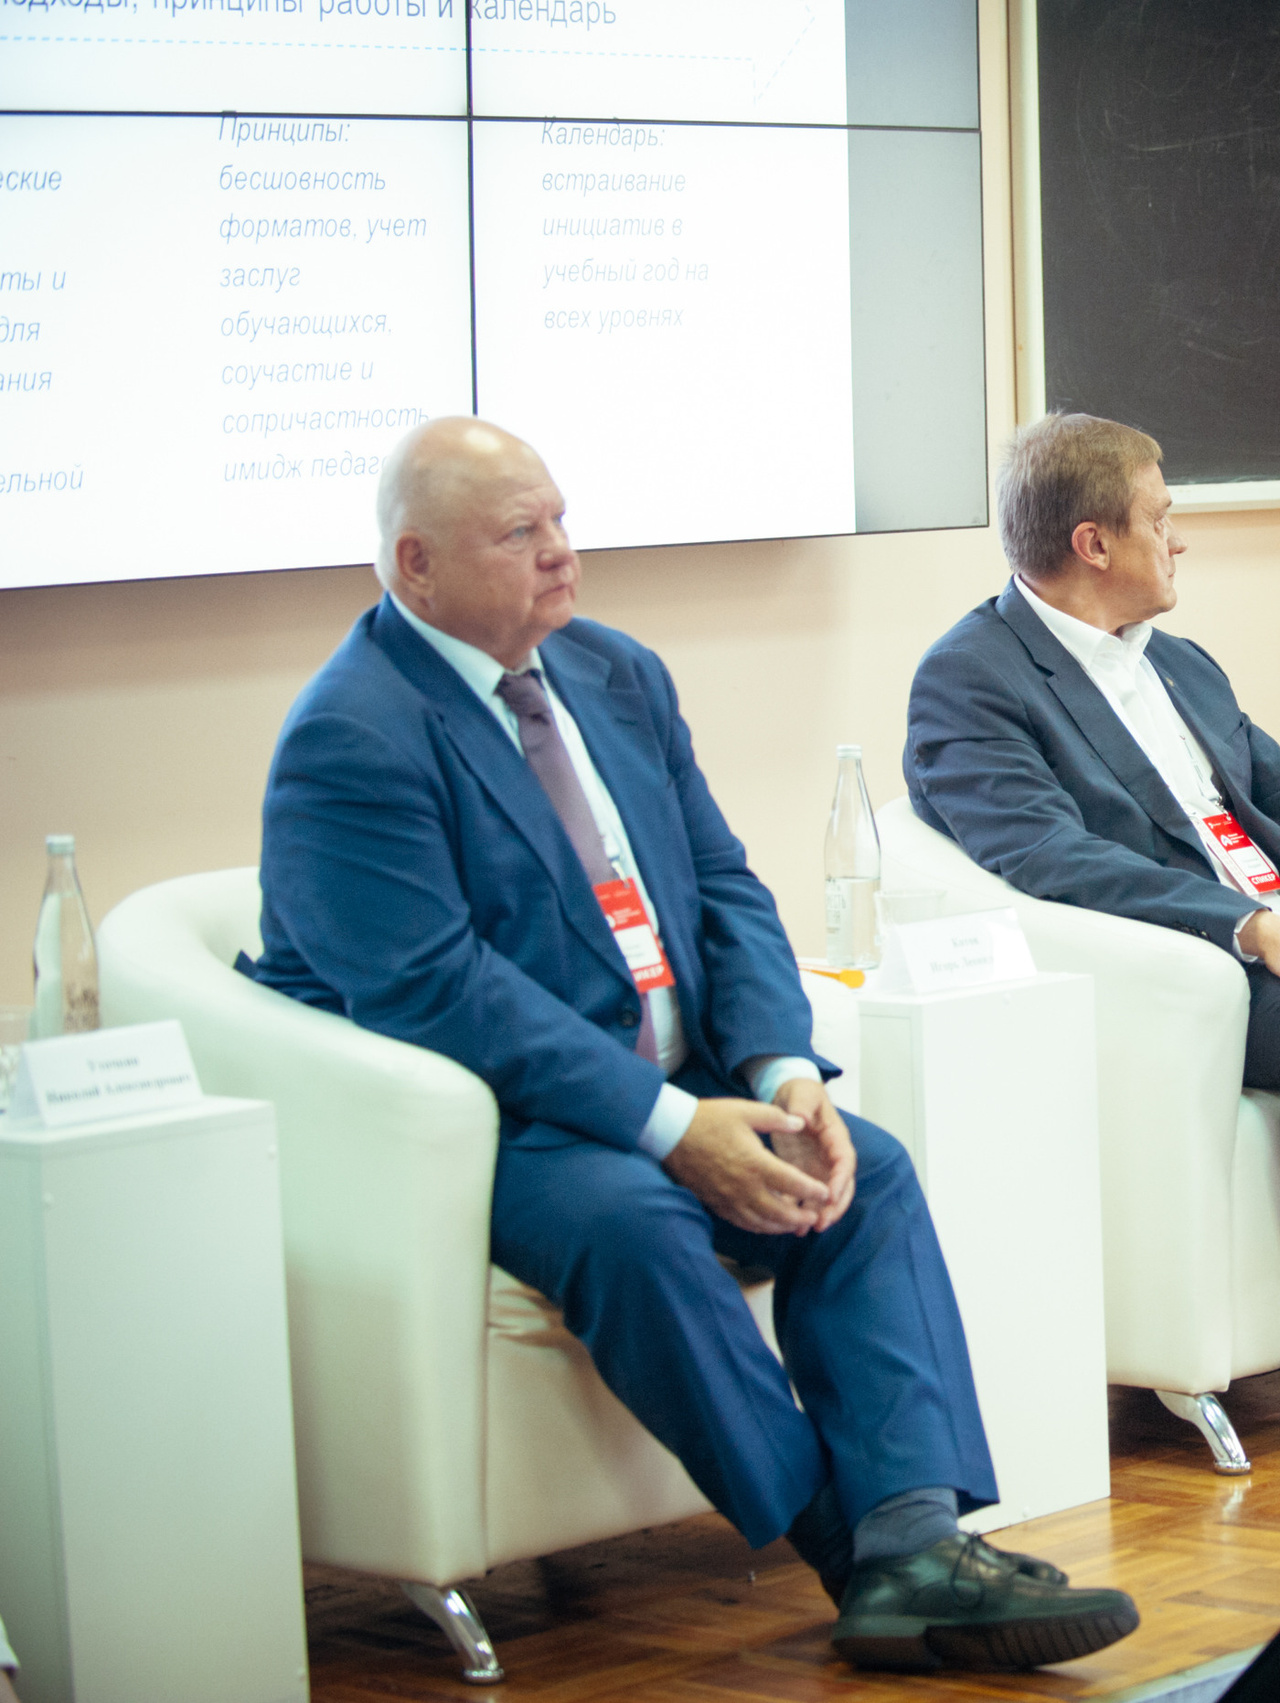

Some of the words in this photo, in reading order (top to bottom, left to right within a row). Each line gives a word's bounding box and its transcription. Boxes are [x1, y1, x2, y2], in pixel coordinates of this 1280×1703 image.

[319, 0, 426, 22] работы
[471, 0, 617, 32] календарь
[219, 110, 350, 148] Принципы:
[541, 115, 665, 152] Календарь:
[219, 164, 386, 191] бесшовность
[542, 172, 686, 197] встраивание
[366, 217, 427, 244] учет
[543, 217, 665, 241] инициатив
[671, 217, 683, 236] в
[0, 271, 41, 291] ты
[52, 271, 66, 291] и
[220, 267, 301, 293] заслуг
[543, 257, 637, 289] учебный
[643, 257, 679, 282] год
[685, 263, 709, 282] на
[0, 315, 40, 343] для
[544, 309, 591, 329] всех
[597, 308, 684, 335] уровнях
[221, 360, 352, 390] соучастие
[361, 359, 374, 381] и
[222, 407, 430, 439] сопричастность
[224, 453, 303, 482] имидж
